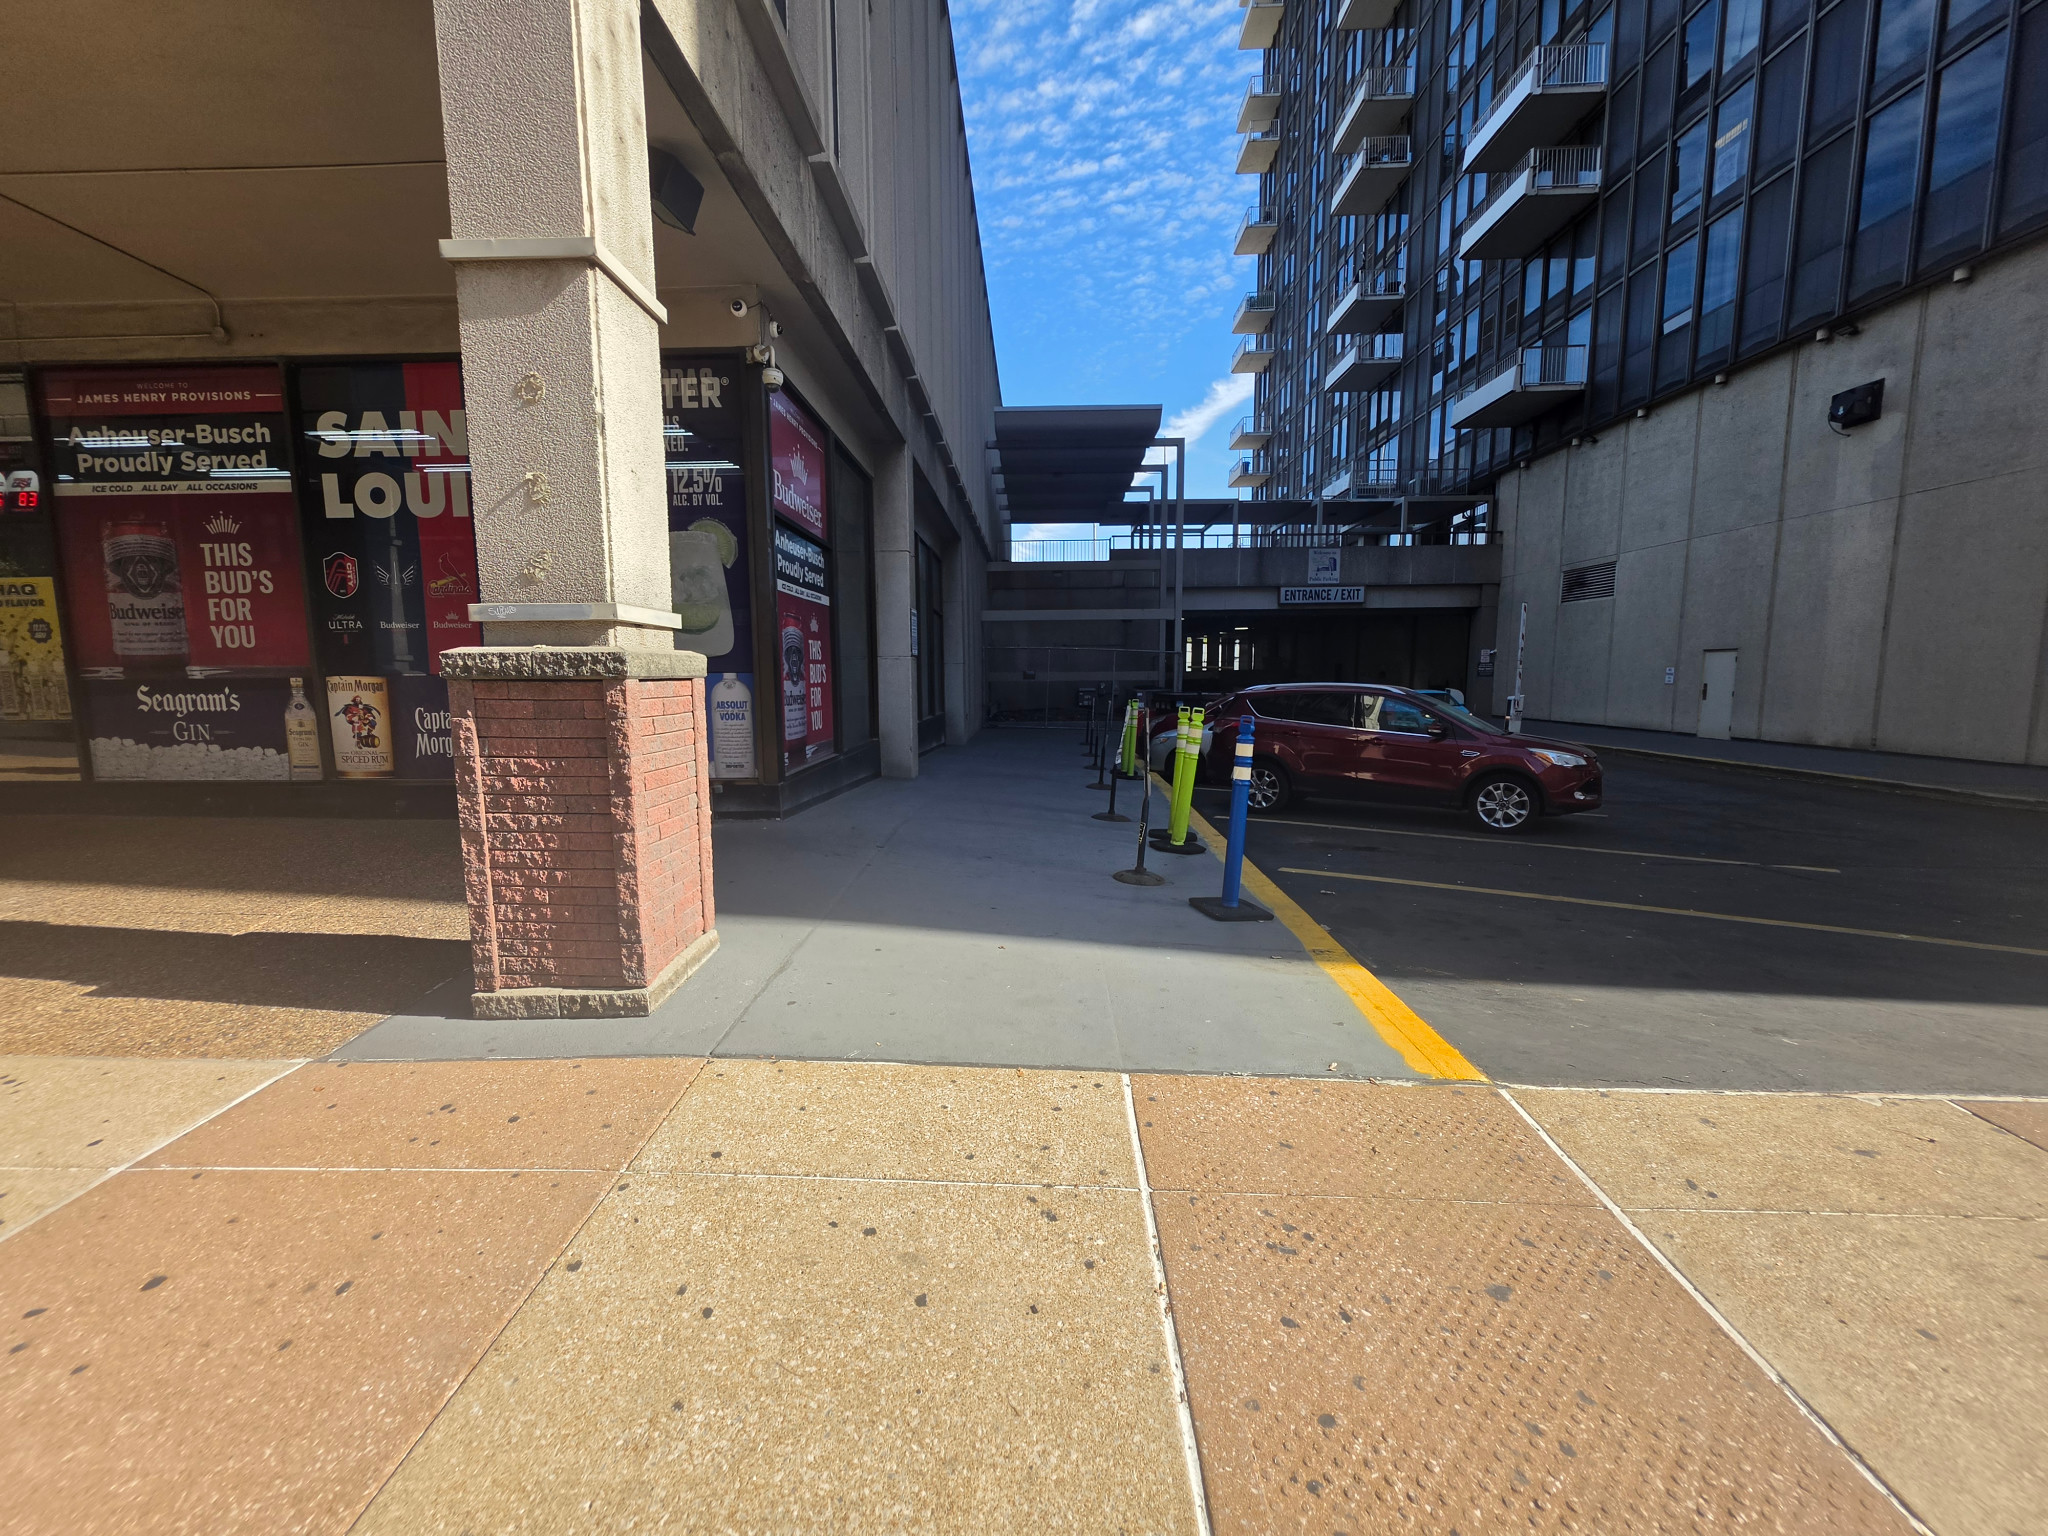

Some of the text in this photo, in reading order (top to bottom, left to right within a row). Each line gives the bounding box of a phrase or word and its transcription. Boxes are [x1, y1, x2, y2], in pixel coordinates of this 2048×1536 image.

[77, 391, 251, 404] JAMES HENRY PROVISIONS
[68, 422, 271, 446] Anheuser-Busch
[316, 409, 469, 459] SAIN
[77, 450, 267, 476] Proudly Served
[92, 485, 107, 493] ICE
[109, 485, 133, 493] COLD
[141, 484, 158, 492] ALL
[161, 484, 178, 492] DAY
[205, 483, 258, 491] OCCASIONS
[671, 468, 722, 494] 12.5%
[18, 492, 38, 507] 83
[321, 472, 469, 519] LOUI
[673, 494, 723, 506] ALC. BY VOL.
[773, 468, 822, 528] Budweiser
[200, 543, 253, 567] THIS
[777, 554, 824, 588] Proudly Served
[205, 570, 274, 594] BUD'S
[6, 599, 45, 607] FLAVOR
[1284, 589, 1332, 601] ENTRANCE
[1341, 589, 1361, 600] EXIT
[208, 598, 253, 621] FOR
[328, 621, 363, 629] ULTRA
[380, 621, 420, 629] Budweiser
[433, 621, 472, 629] Budweiser
[210, 625, 256, 649] YOU
[808, 640, 822, 660] THIS
[810, 663, 826, 684] BUD'S
[326, 676, 384, 694] Captain Morgan
[137, 684, 240, 718] Seagram's
[716, 701, 748, 709] ABSOLUT
[810, 687, 822, 708] FOR
[720, 713, 746, 721] VODKA
[811, 710, 823, 731] YOU
[341, 755, 389, 764] SPICED RUM
